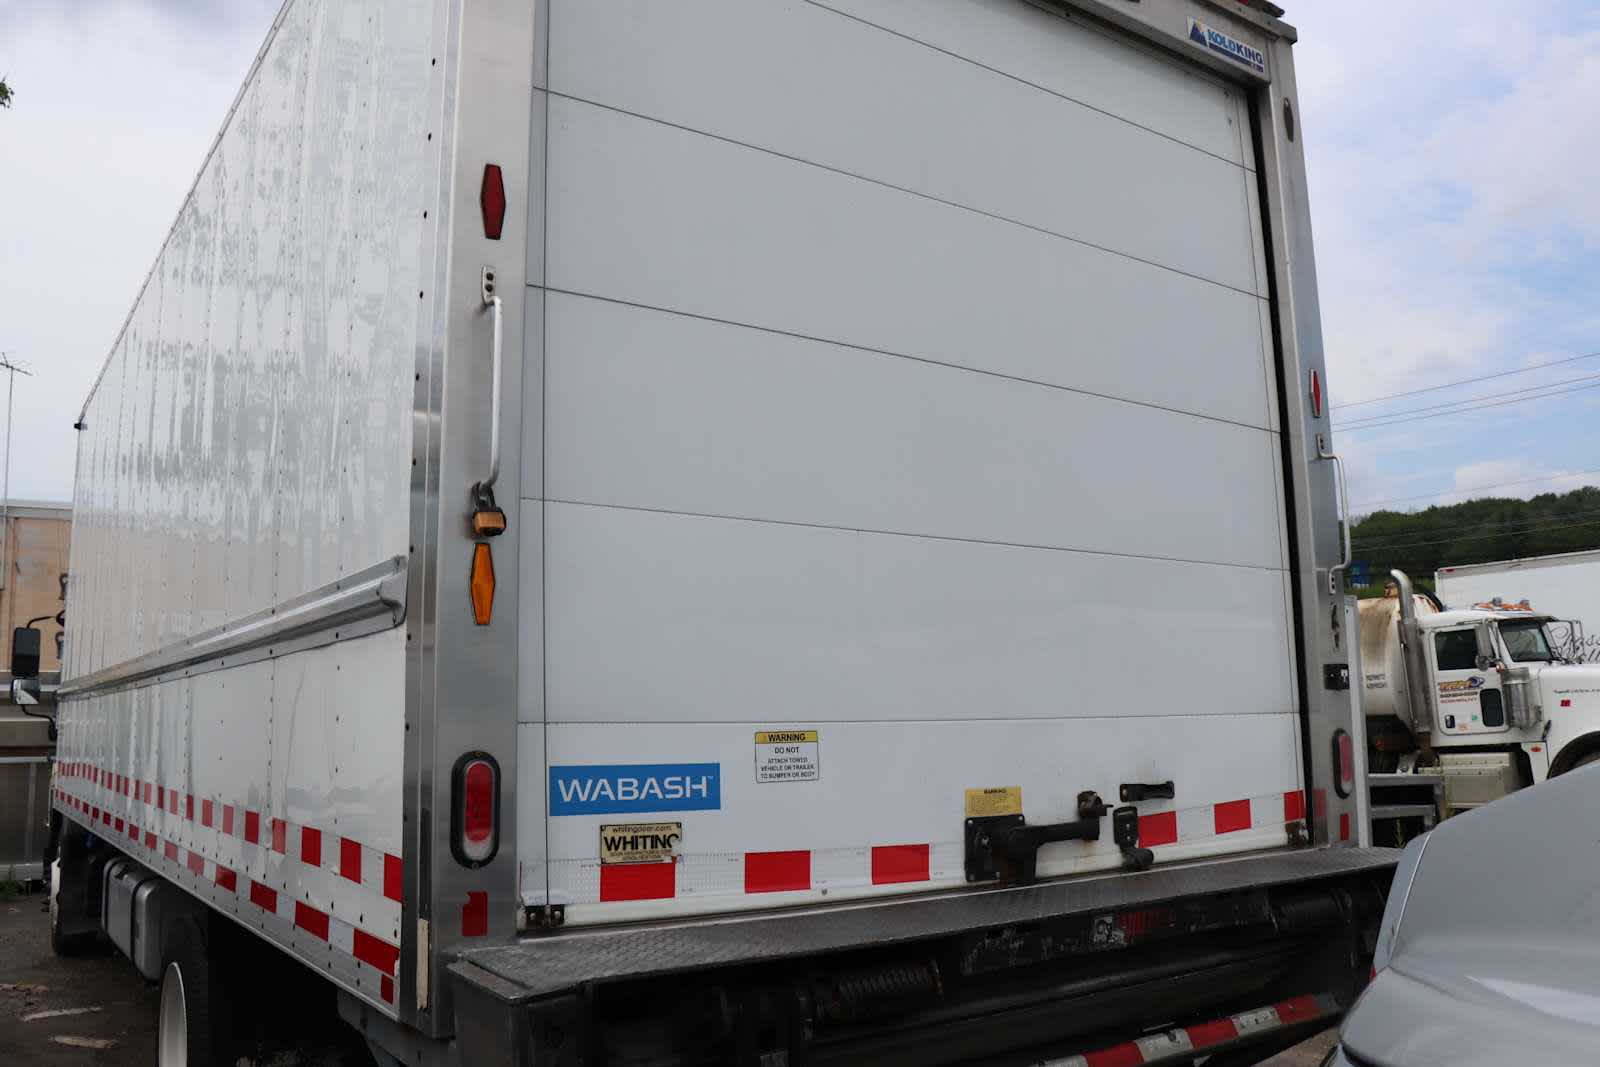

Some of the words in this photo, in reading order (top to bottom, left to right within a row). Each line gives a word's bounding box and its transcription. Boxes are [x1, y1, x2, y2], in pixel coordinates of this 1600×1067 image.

[768, 733, 806, 742] WARNING
[774, 746, 785, 754] DO
[557, 775, 708, 803] WABASH
